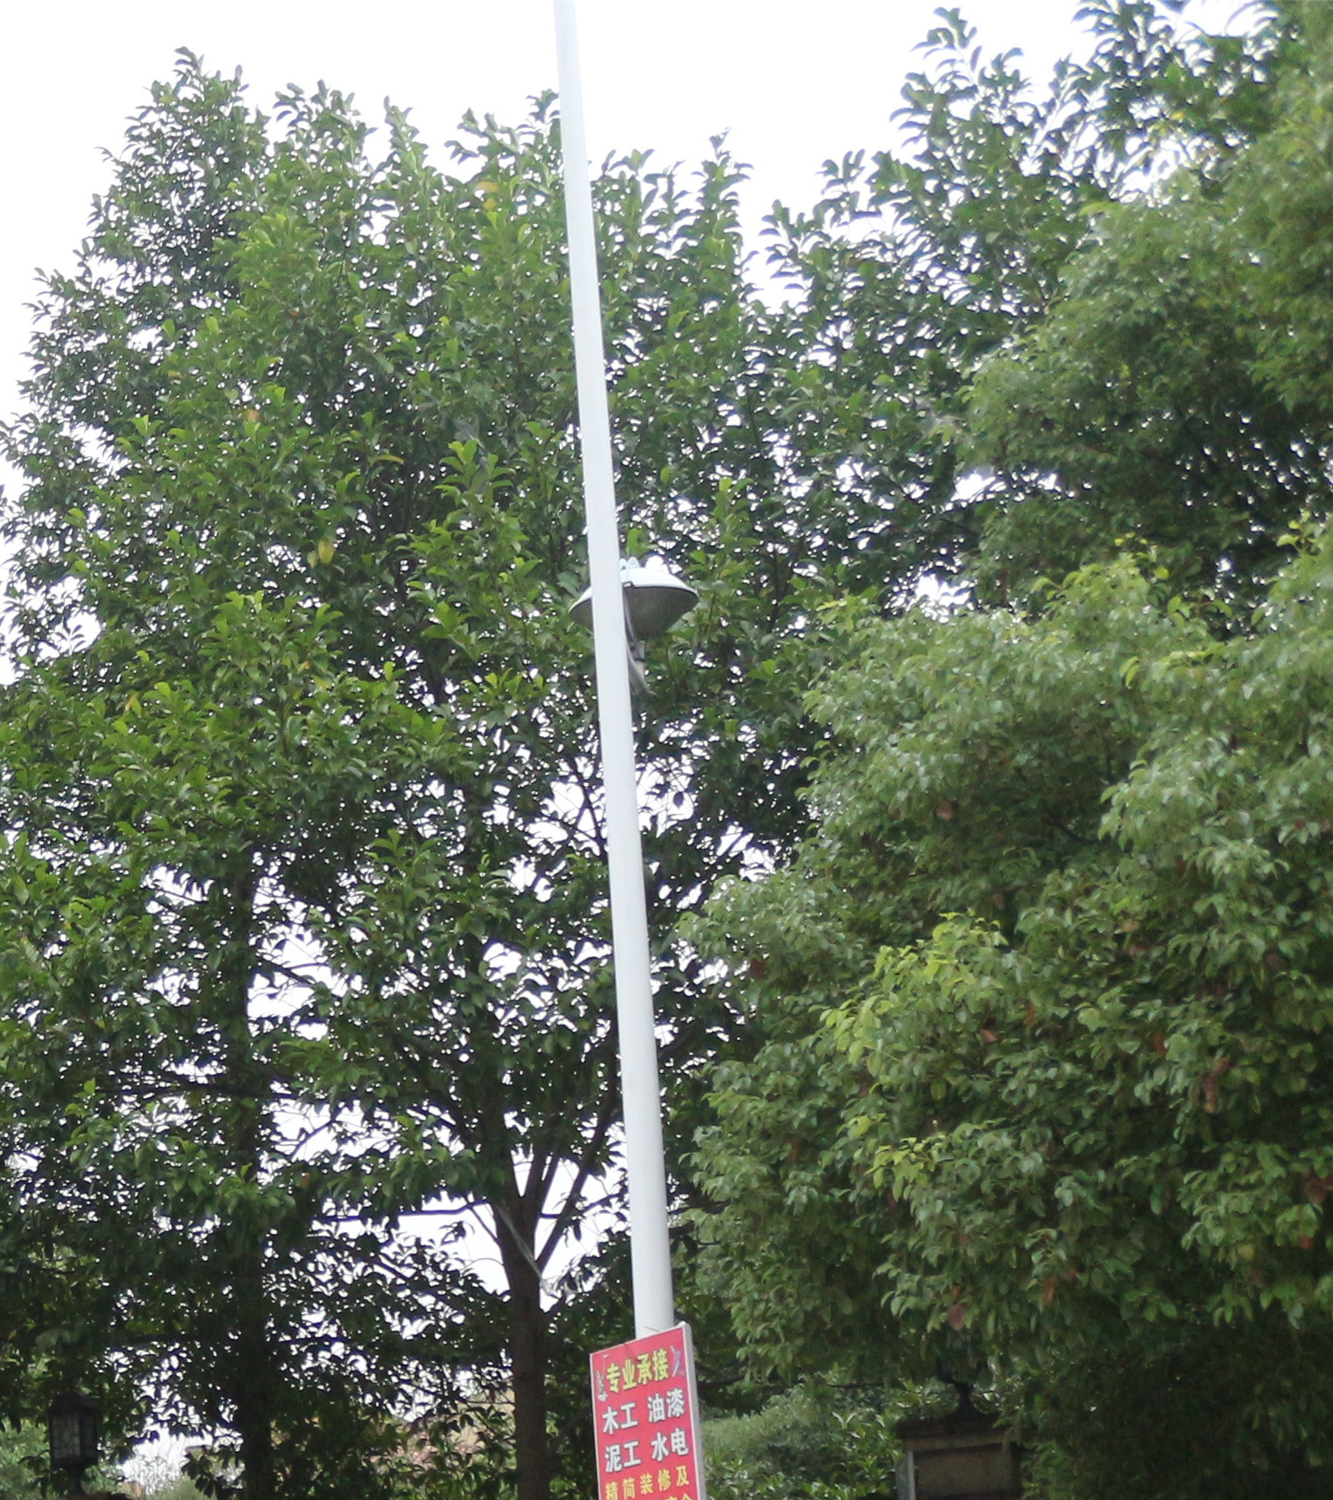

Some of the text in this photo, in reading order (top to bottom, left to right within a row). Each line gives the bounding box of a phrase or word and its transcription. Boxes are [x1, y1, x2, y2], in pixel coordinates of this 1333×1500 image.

[606, 1348, 669, 1393] 专业承接
[602, 1388, 685, 1435] 木工 油漆
[605, 1427, 689, 1473] 泥工 水电
